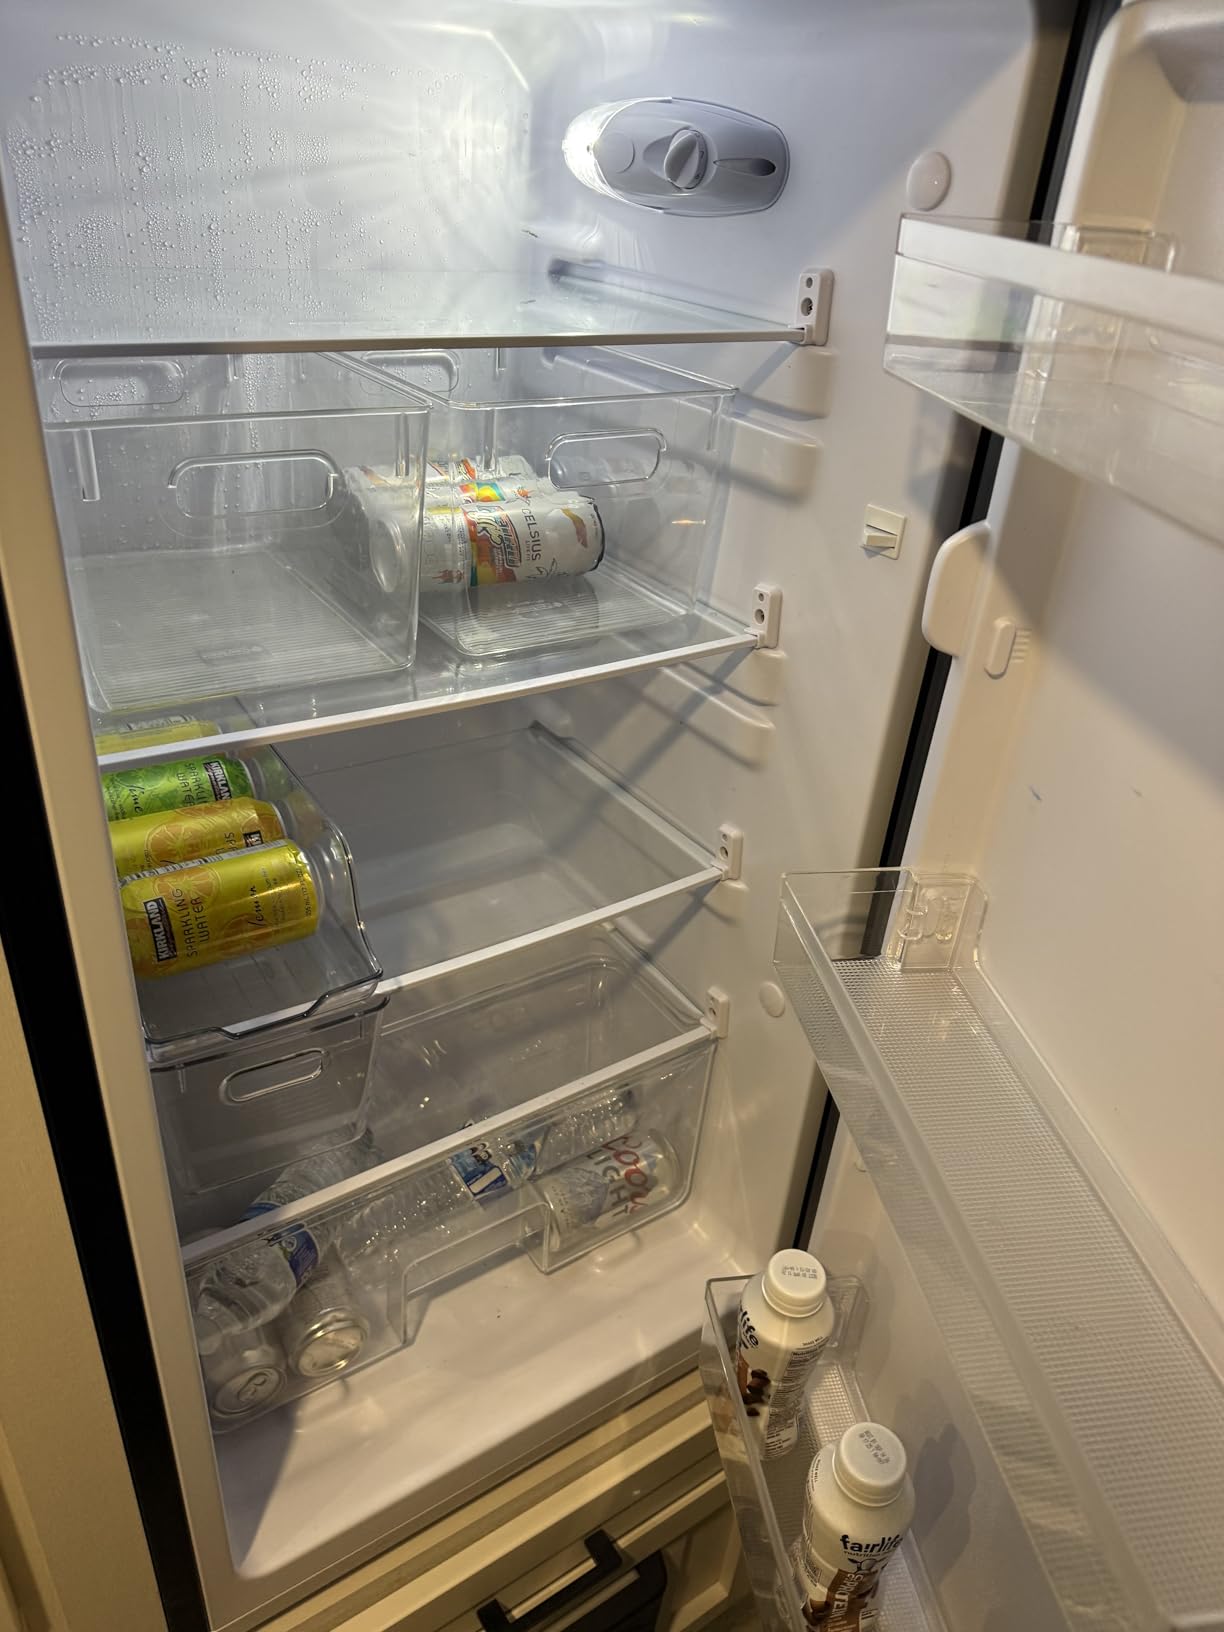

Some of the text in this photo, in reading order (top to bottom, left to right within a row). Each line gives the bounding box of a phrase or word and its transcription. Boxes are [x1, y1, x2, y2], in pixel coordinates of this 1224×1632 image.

[521, 508, 542, 561] CELSIUS
[185, 763, 209, 804] SPARKLI
[209, 761, 232, 800] KIRKLAN
[146, 900, 170, 960] KIRKLAND
[172, 888, 198, 958] SPARKLING
[190, 896, 210, 944] WATER
[586, 1149, 629, 1217] LIGHT
